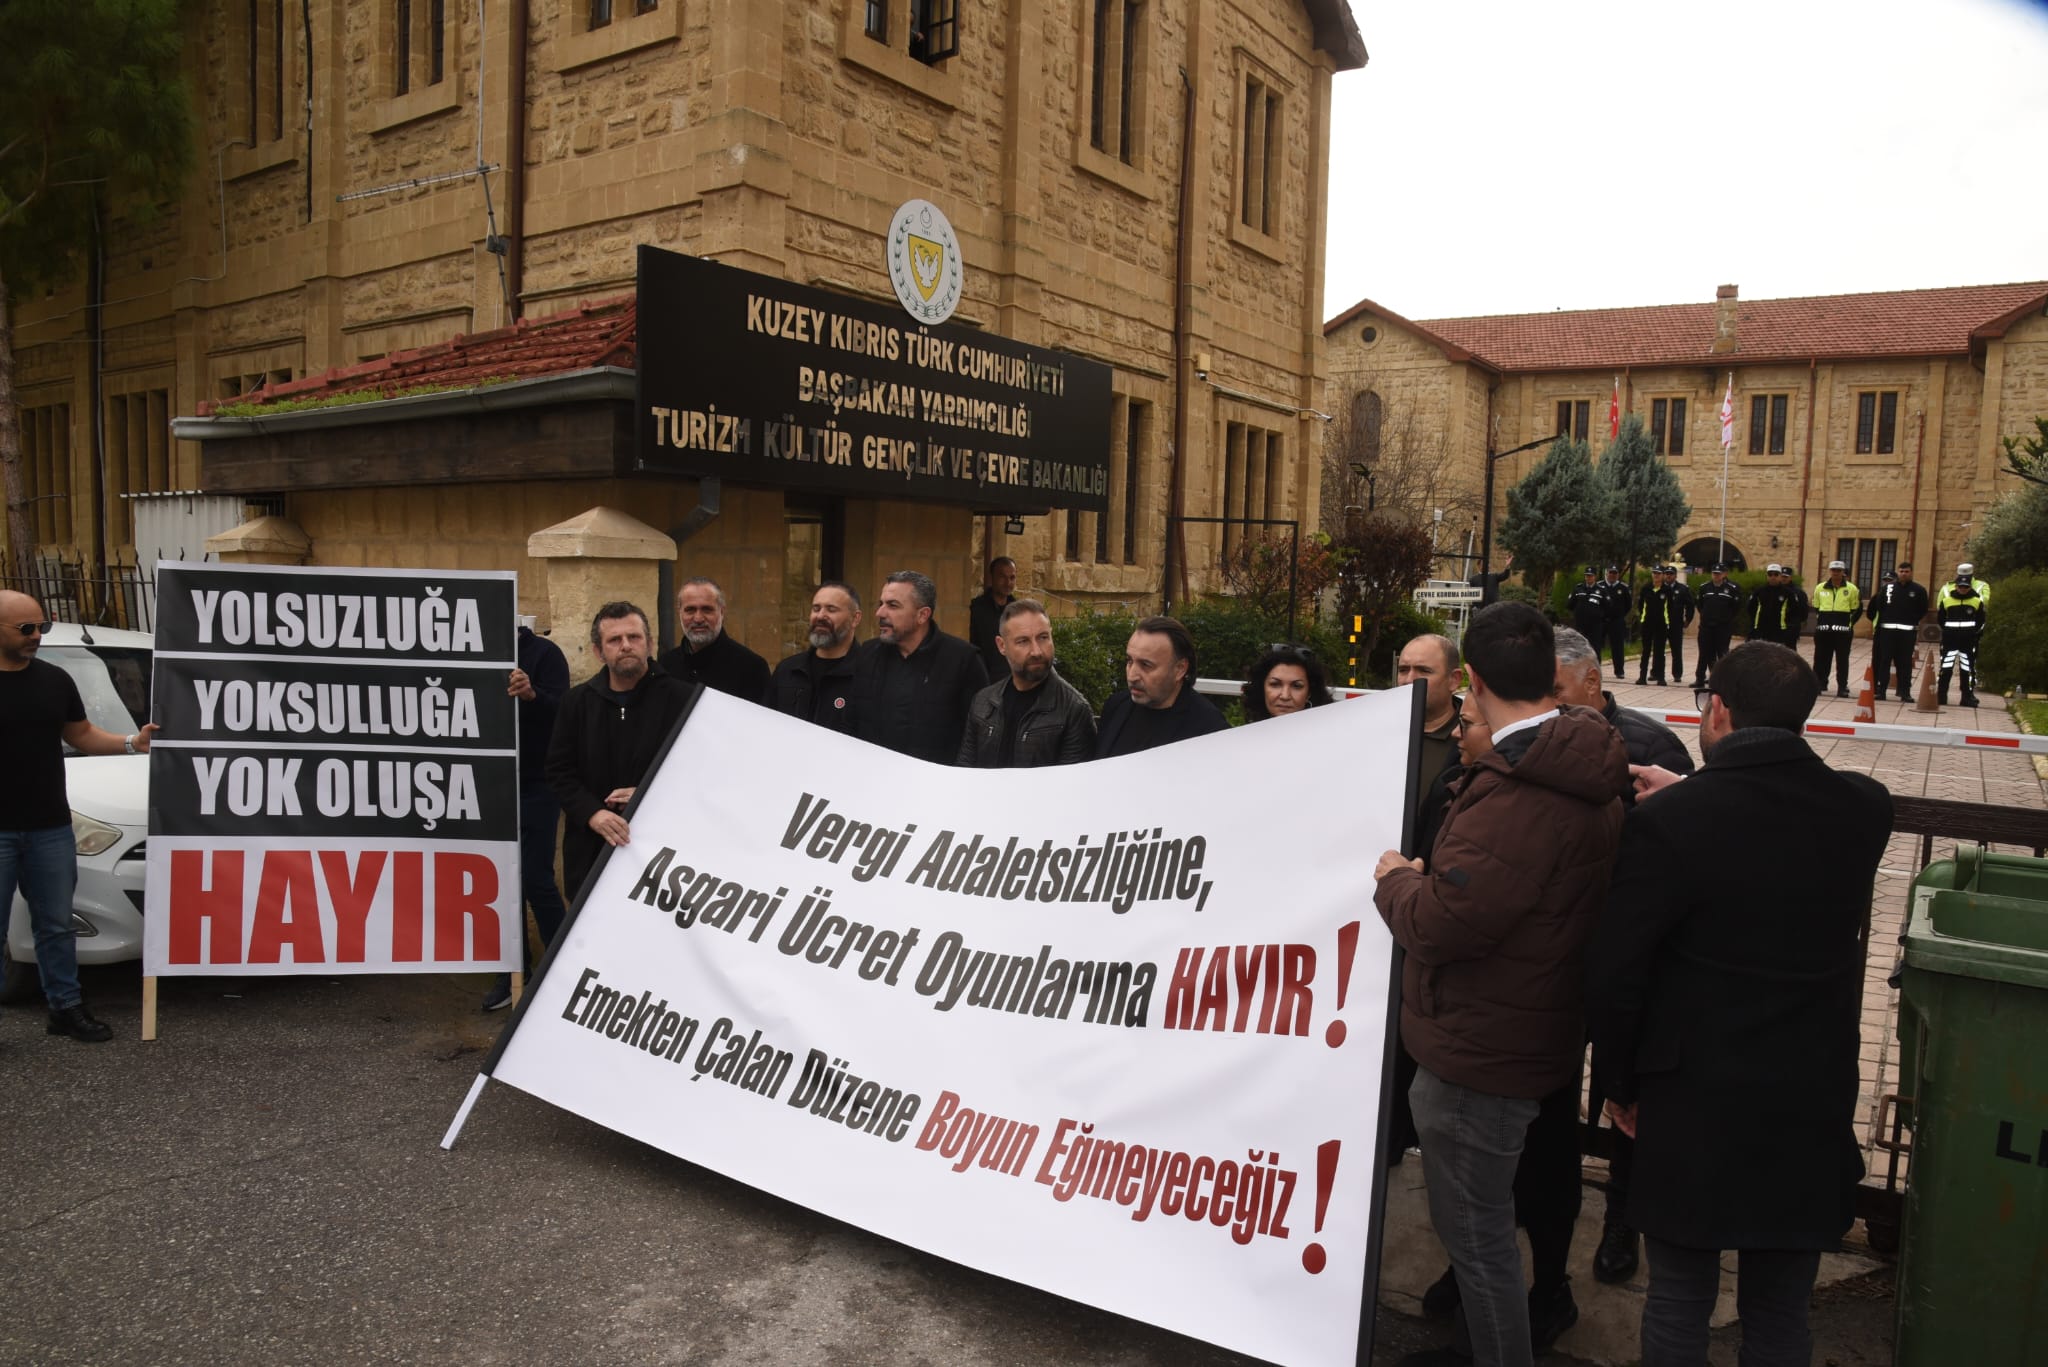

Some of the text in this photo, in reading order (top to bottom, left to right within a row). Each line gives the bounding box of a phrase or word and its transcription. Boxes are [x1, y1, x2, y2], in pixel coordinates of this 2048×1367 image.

[747, 294, 1065, 398] KUZEY KIBRIS TÜRK CUMHURİYETİ
[651, 403, 1107, 497] TURİZM KÜLTÜR GENÇLİK VE ÇEVRE BAKANLIĞI
[799, 366, 1031, 440] BAŞBAKAN YARDIMCILIĞI
[191, 585, 484, 653] YOLSUZLUĞA
[193, 677, 480, 739] YOKSULLUĞA
[192, 756, 482, 831] YOK OLUŞA
[780, 792, 1214, 915] Vergi Adaletsizliğine,
[168, 849, 501, 965] HAYIR
[627, 846, 790, 930] Asgari
[777, 886, 921, 987] Ücret
[914, 931, 1159, 1029] Oyunlarına
[561, 967, 700, 1066] Emekten
[690, 1017, 794, 1101] Çalan
[787, 1048, 922, 1143] Düzene
[914, 1090, 1040, 1174] Boyun
